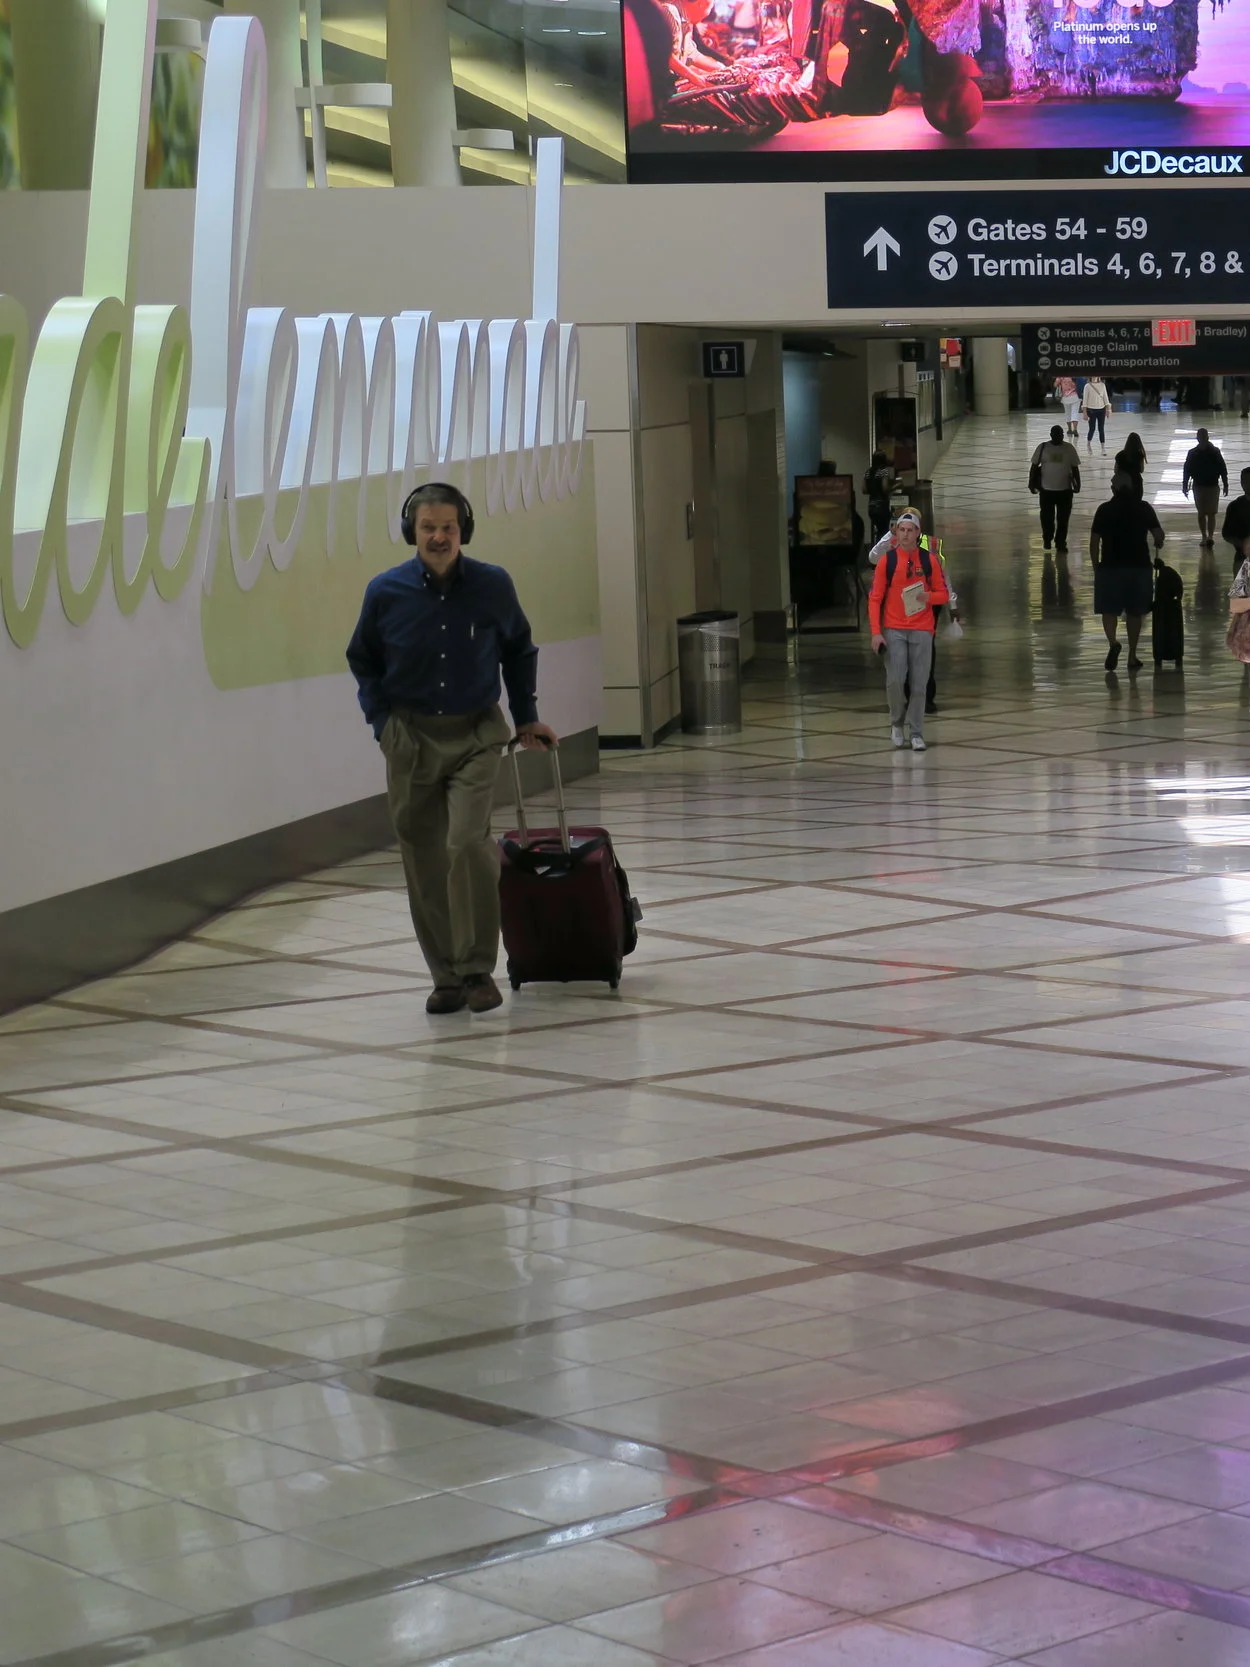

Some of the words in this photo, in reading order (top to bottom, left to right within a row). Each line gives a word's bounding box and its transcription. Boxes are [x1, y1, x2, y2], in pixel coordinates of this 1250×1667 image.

[1053, 21, 1104, 32] Platinum
[1106, 22, 1141, 33] opens
[1143, 22, 1157, 33] up
[1078, 34, 1097, 44] the
[1099, 34, 1133, 44] world.
[1104, 150, 1244, 175] JCDecaux
[967, 217, 1047, 241] Gates
[1055, 217, 1088, 240] 54
[1115, 216, 1148, 240] 59
[967, 252, 1099, 276] Terminals
[1106, 252, 1131, 280] 4,
[1139, 252, 1163, 279] 6,
[1171, 251, 1191, 279] 7,
[1199, 251, 1216, 274] 8
[1224, 250, 1244, 274] &
[1055, 328, 1106, 339] Terminals
[1108, 327, 1118, 340] 4,
[1120, 327, 1130, 339] 6,
[1133, 327, 1141, 339] 7,
[1144, 327, 1151, 337] 8
[1204, 326, 1247, 338] Bradley)
[1158, 319, 1192, 343] EXIT
[1055, 342, 1103, 355] Baggage
[1106, 342, 1138, 352] Claim
[1055, 357, 1096, 367] Ground
[1100, 357, 1180, 368] Transportation
